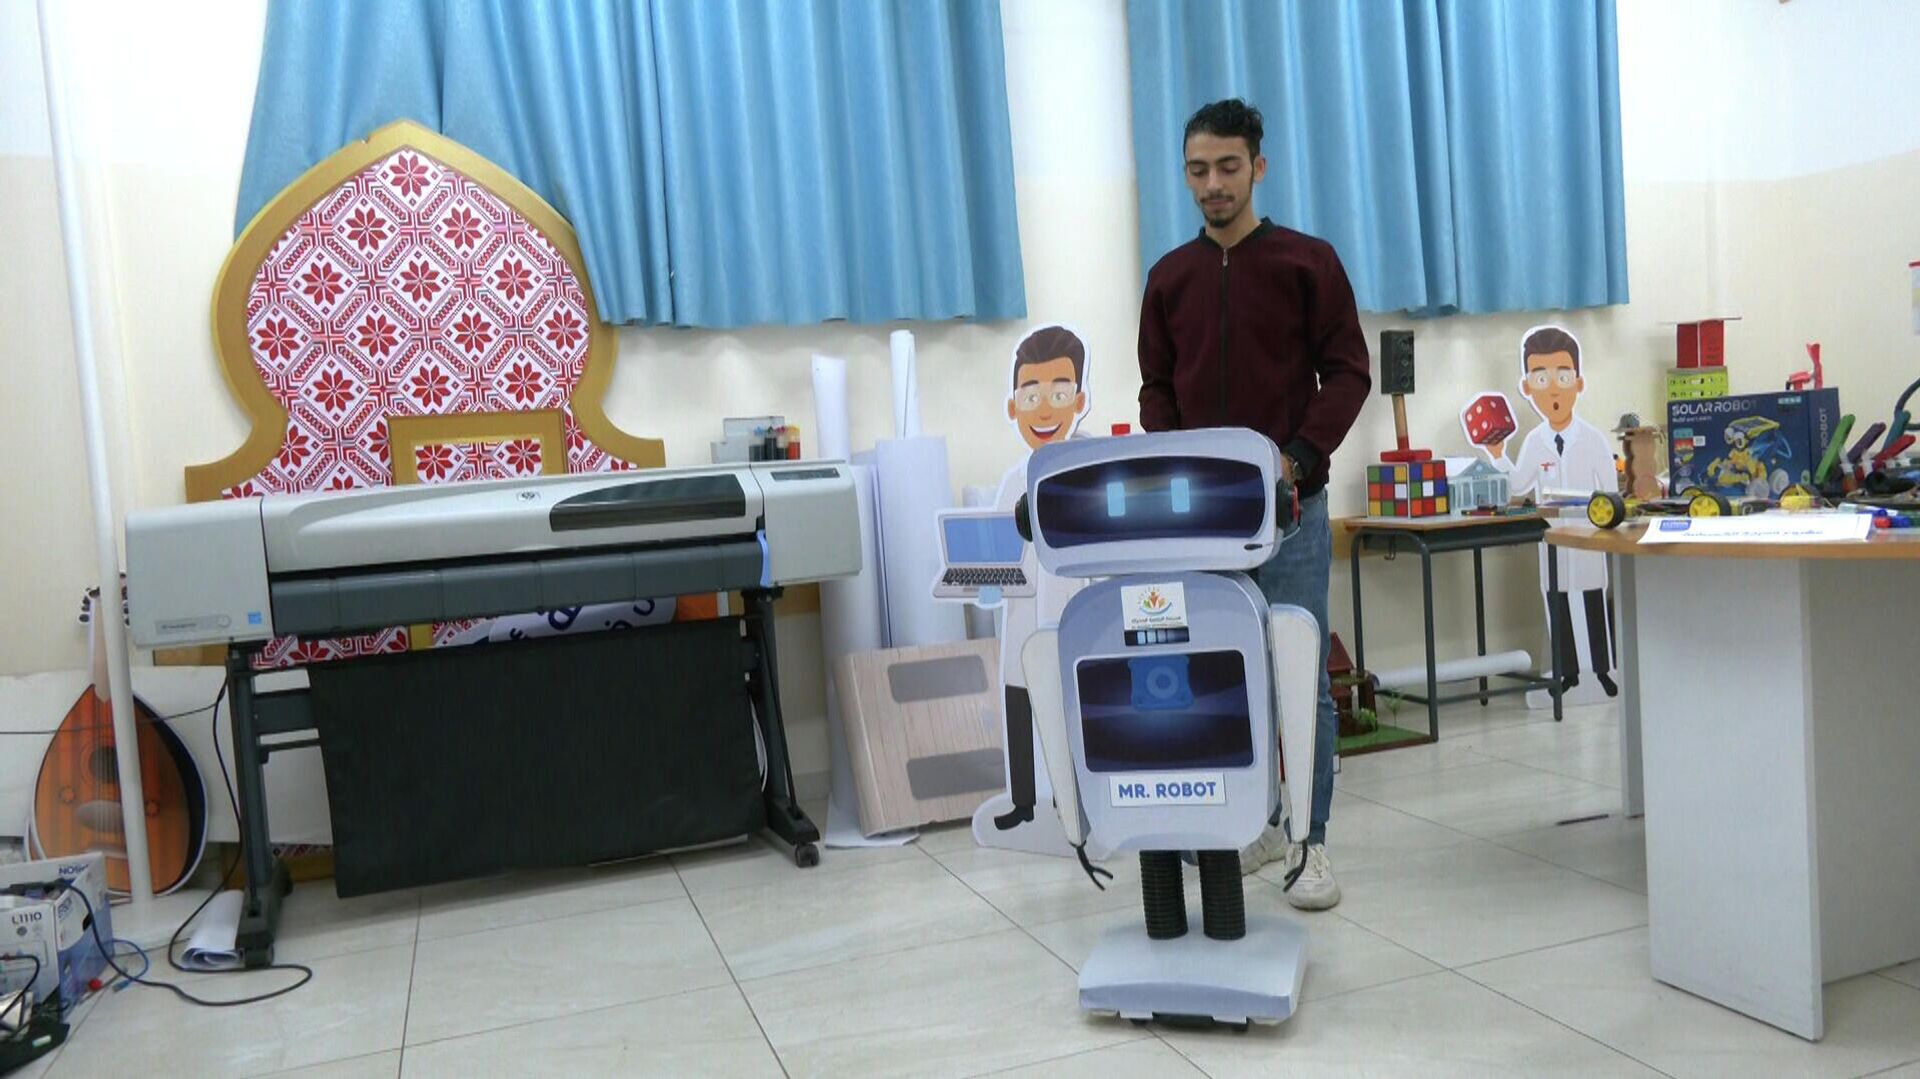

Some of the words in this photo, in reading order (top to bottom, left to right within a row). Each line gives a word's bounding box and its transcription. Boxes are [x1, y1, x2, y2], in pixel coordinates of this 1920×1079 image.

[1118, 783, 1150, 798] MR.
[1156, 781, 1216, 798] ROBOT
[12, 911, 42, 925] L1110
